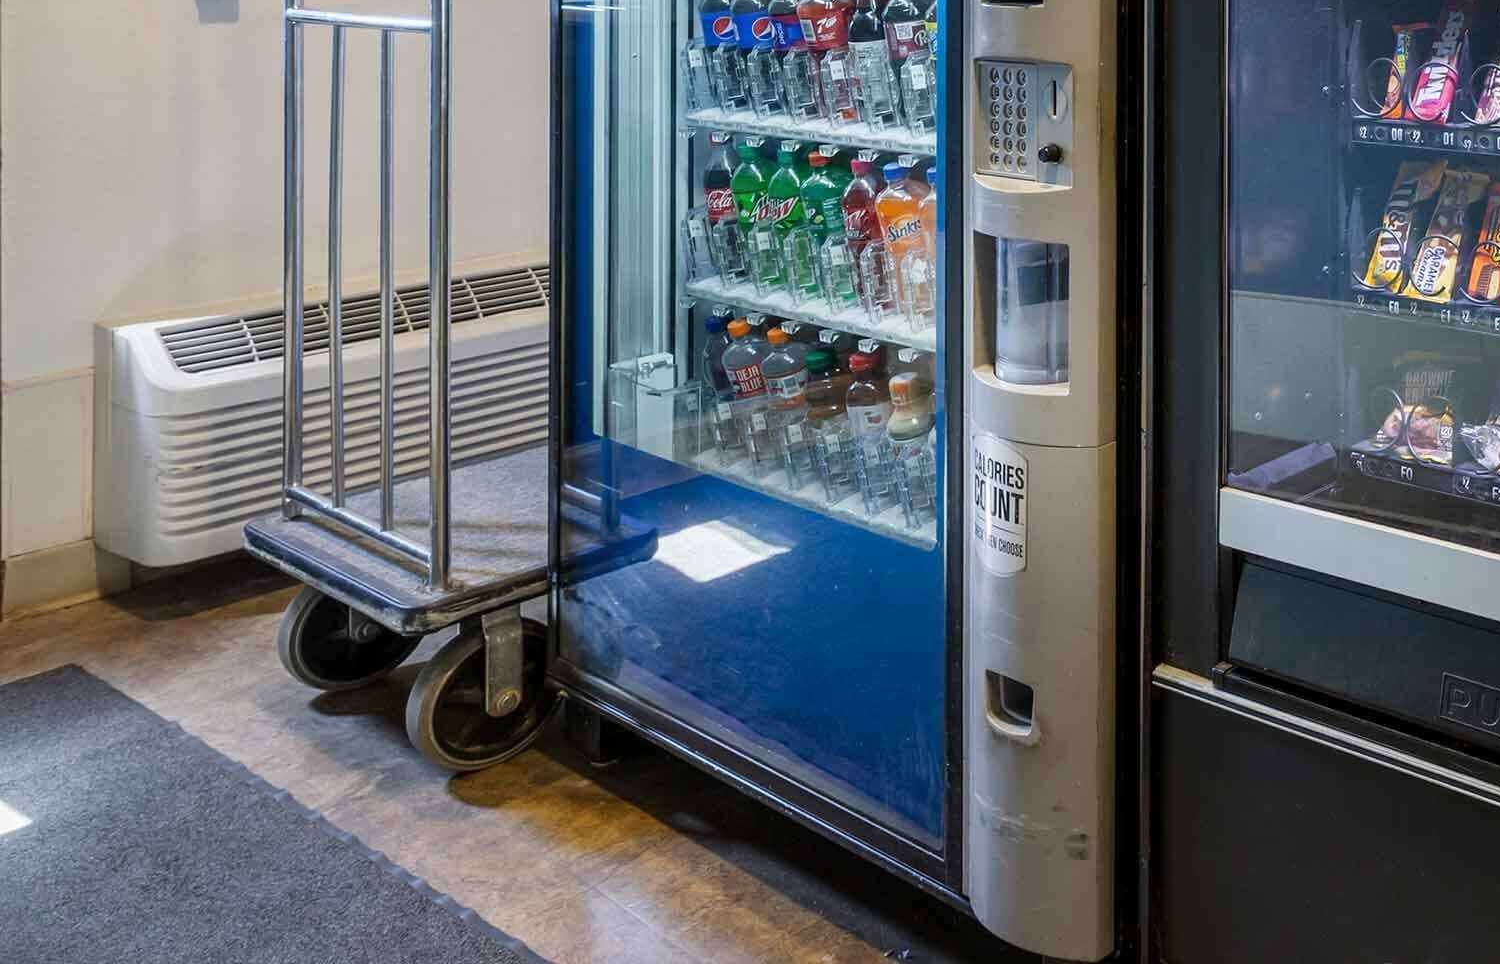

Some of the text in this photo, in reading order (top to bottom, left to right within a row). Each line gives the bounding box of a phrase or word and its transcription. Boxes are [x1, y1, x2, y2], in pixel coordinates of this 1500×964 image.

[735, 364, 760, 381] DEJA
[740, 377, 763, 393] BLUE
[975, 447, 1025, 490] CALORIES
[974, 473, 1024, 525] COUNT
[998, 538, 1024, 558] CHOOSE
